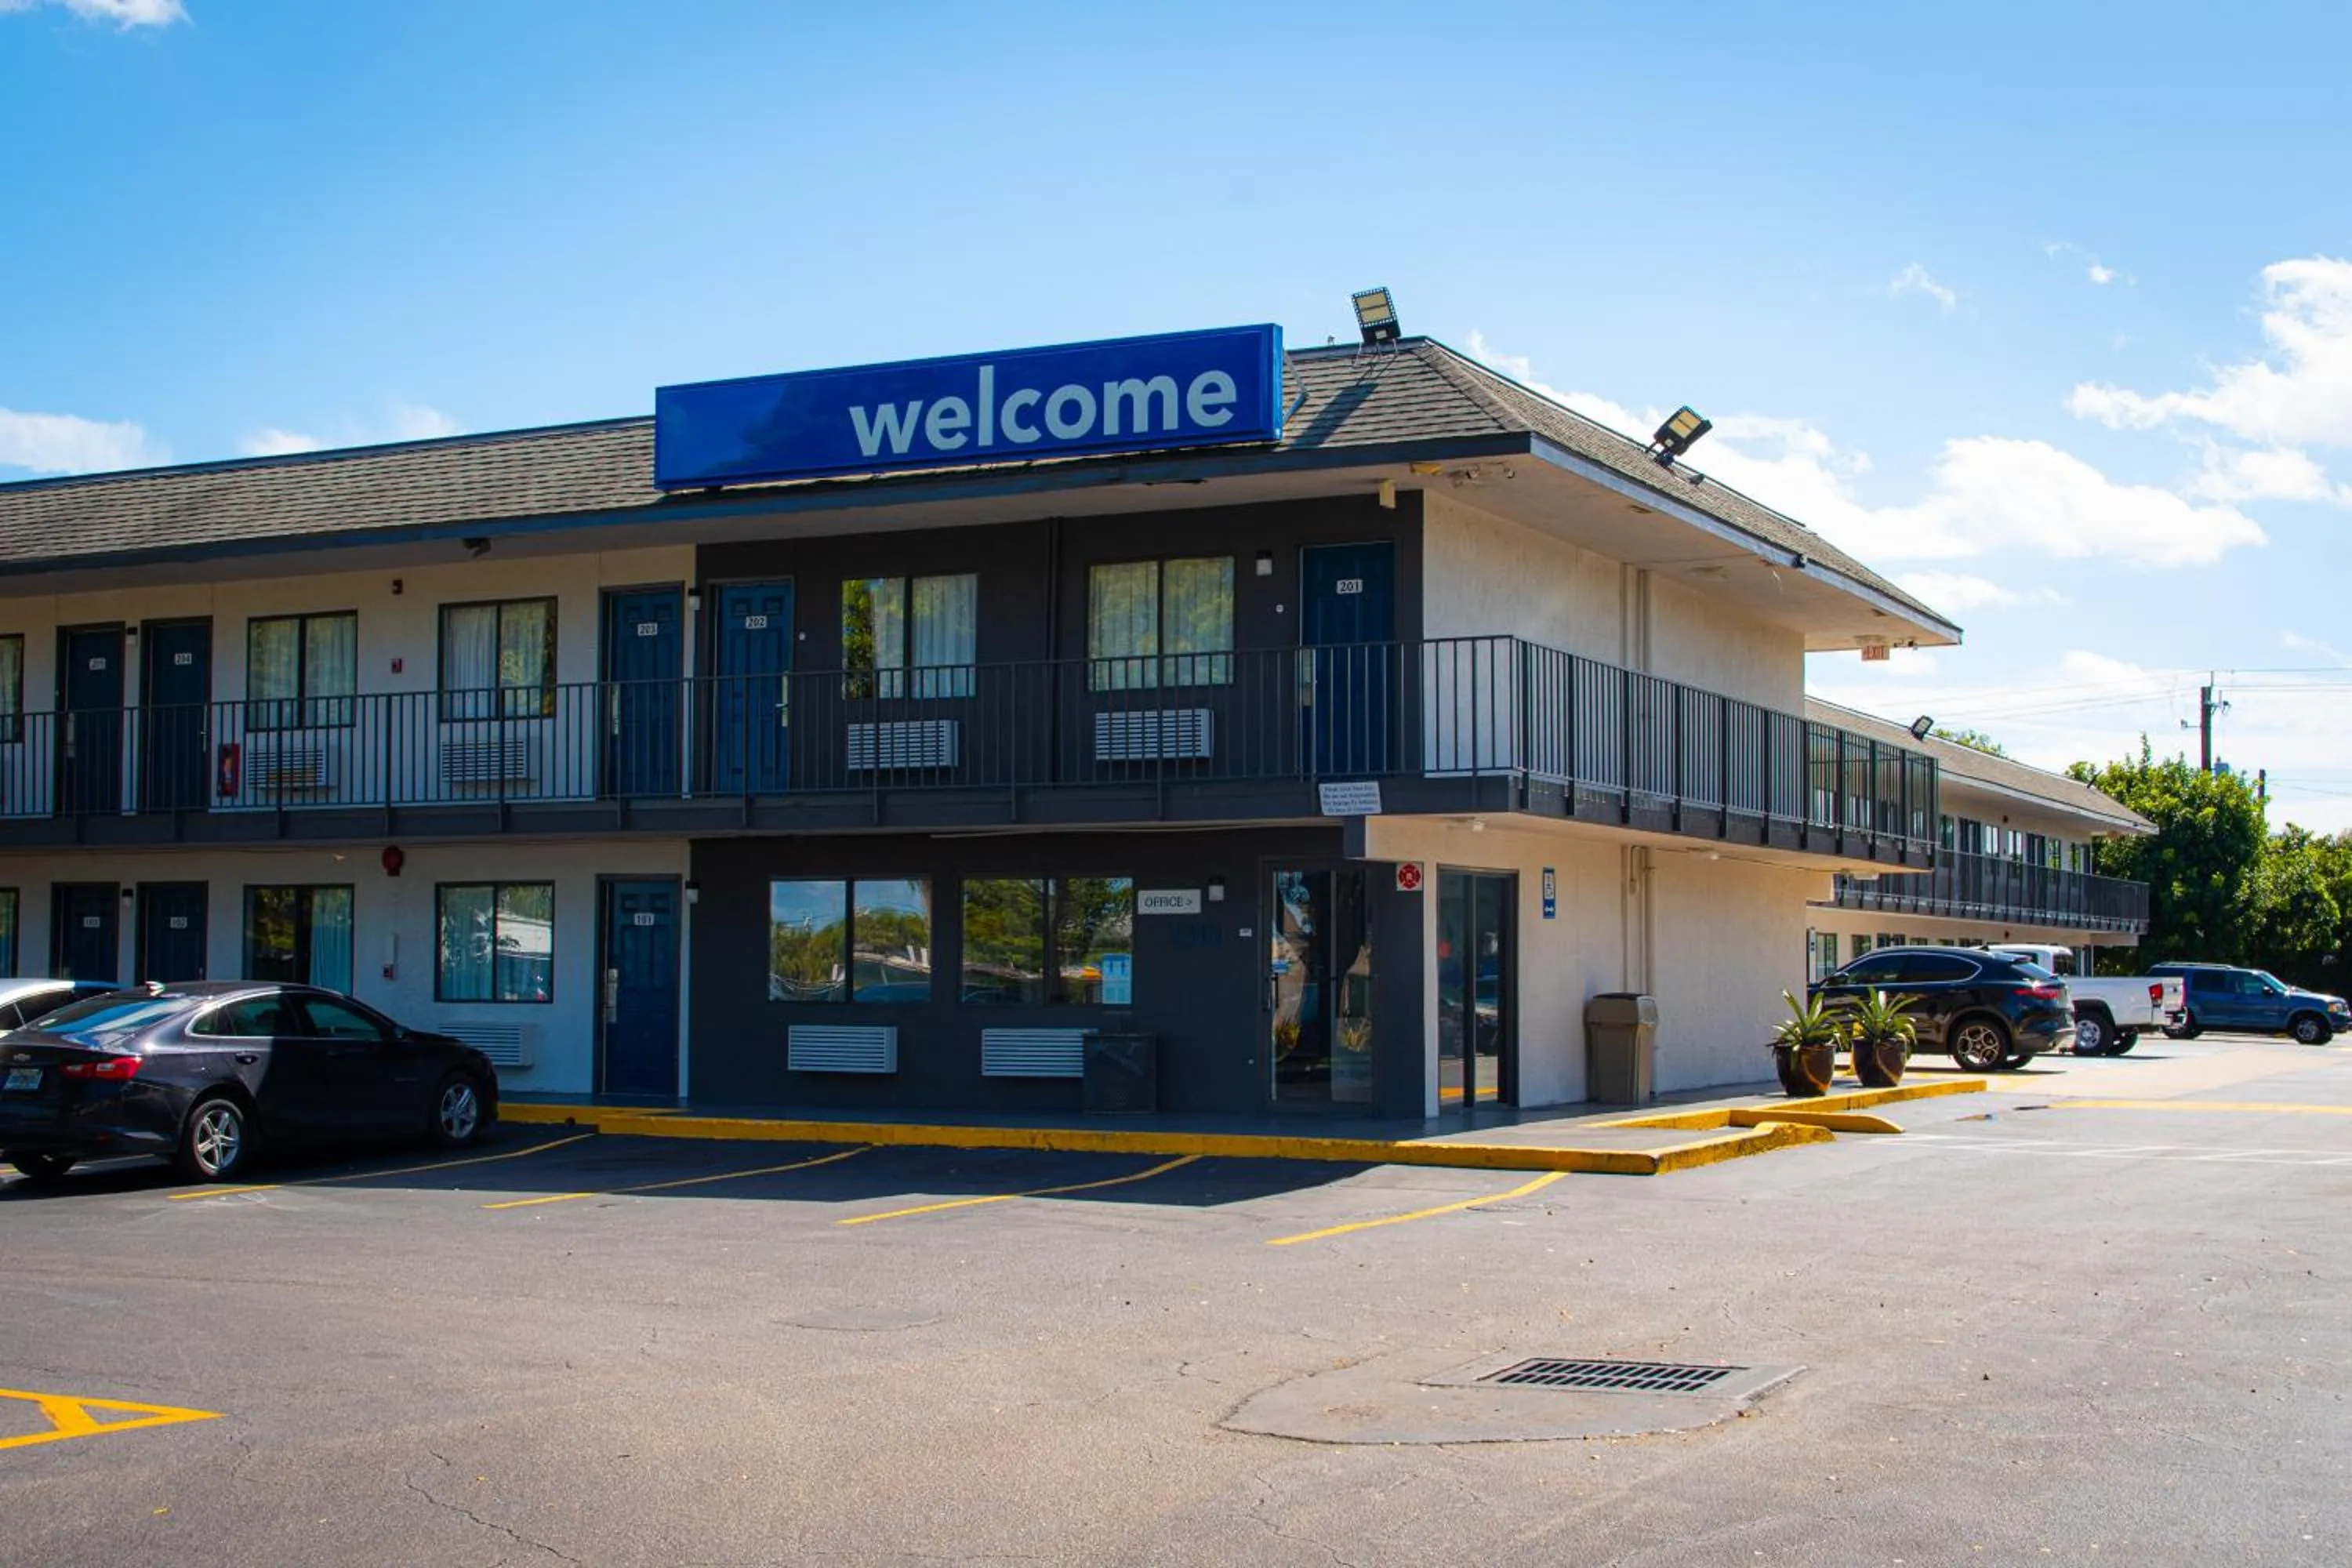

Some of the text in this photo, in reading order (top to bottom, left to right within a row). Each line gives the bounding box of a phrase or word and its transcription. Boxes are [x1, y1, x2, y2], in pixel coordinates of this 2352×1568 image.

[849, 365, 1236, 456] welcome
[1341, 582, 1358, 591] 201
[748, 617, 765, 627] 202
[1145, 896, 1183, 907] OFFICE
